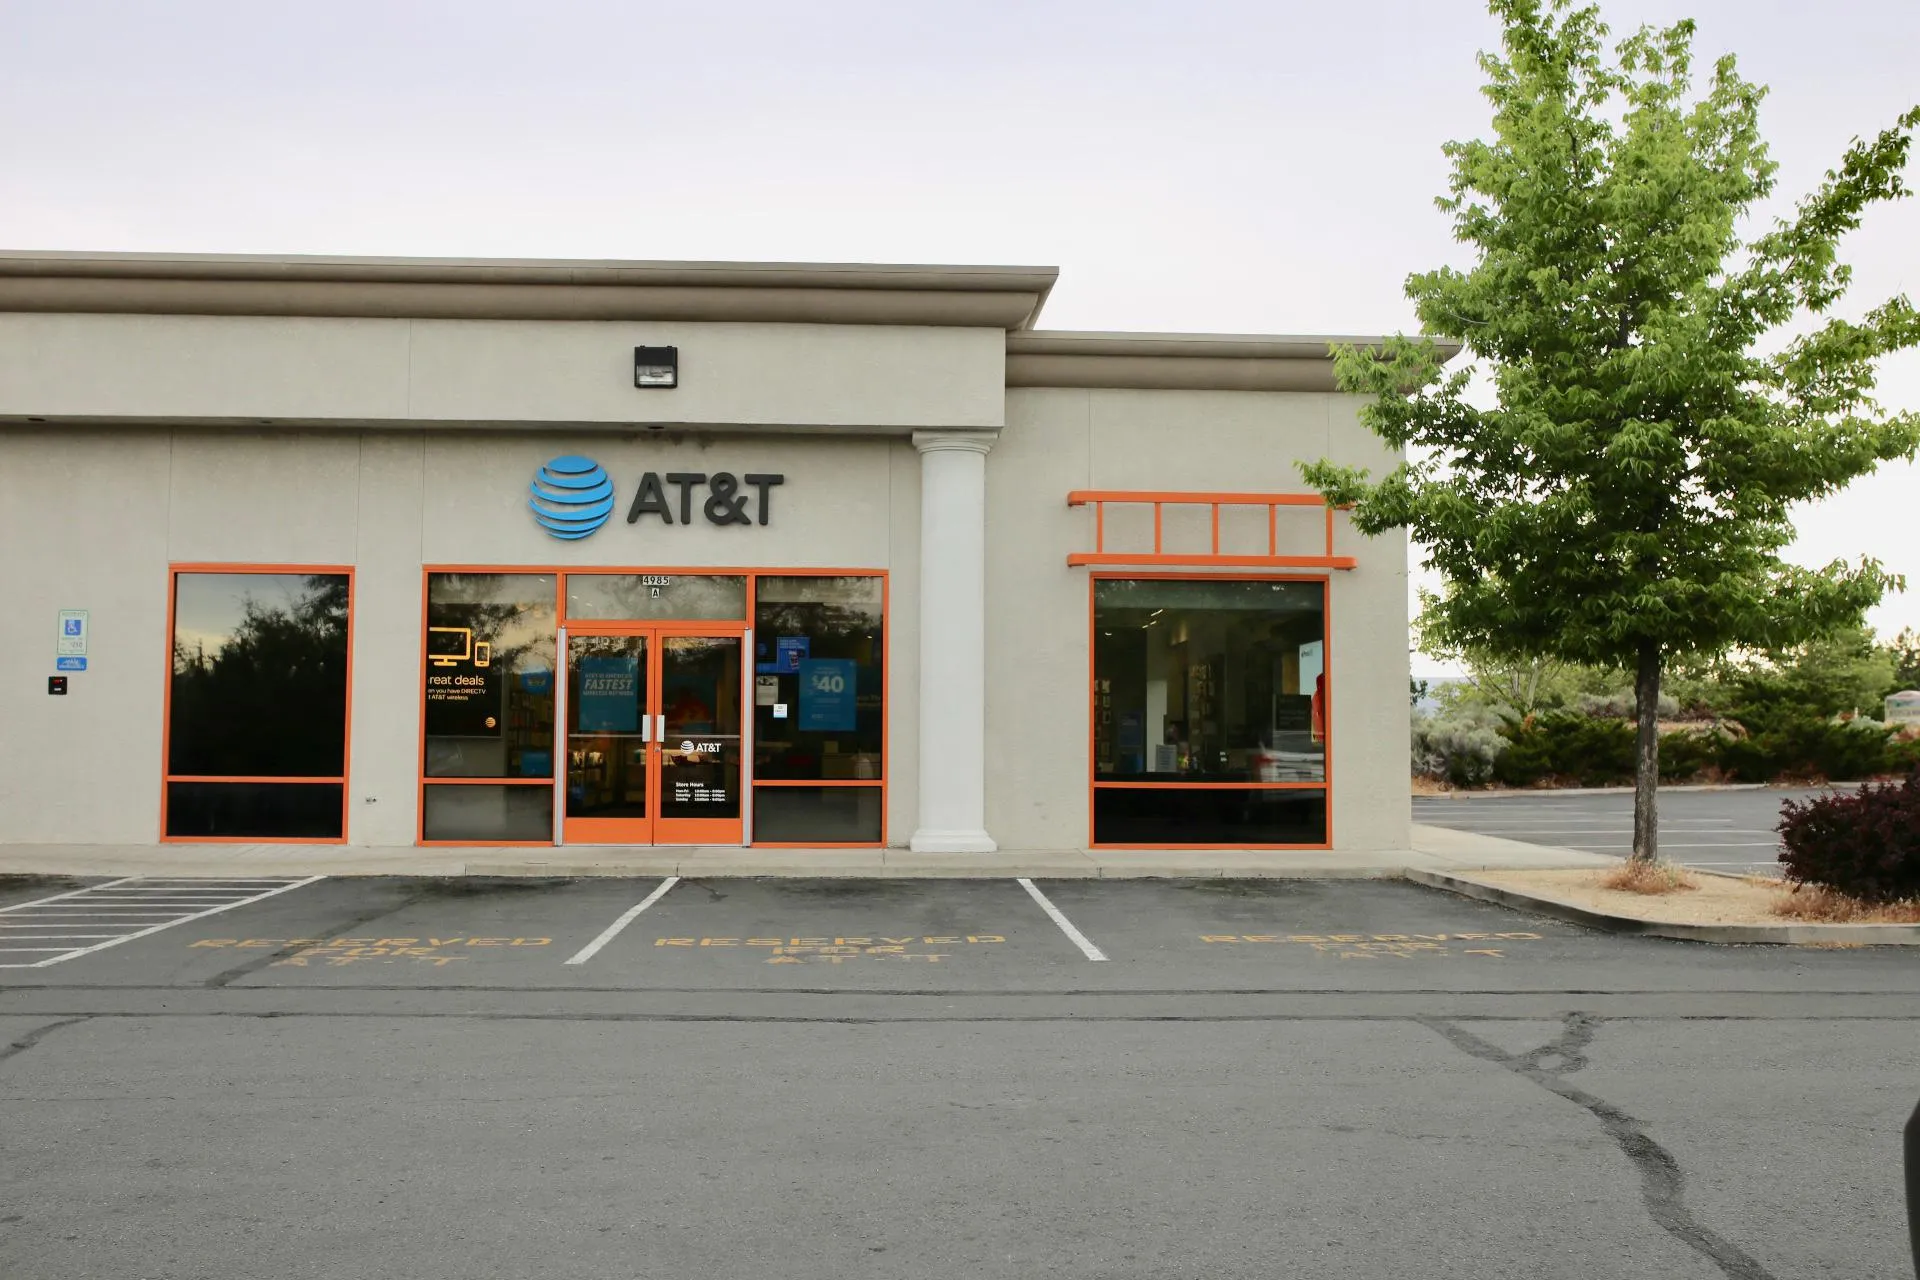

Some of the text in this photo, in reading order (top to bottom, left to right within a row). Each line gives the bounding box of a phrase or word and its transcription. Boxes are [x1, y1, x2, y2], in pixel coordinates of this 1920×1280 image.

[626, 472, 785, 525] AT&T
[643, 576, 669, 585] 4985
[652, 588, 659, 597] A
[428, 674, 485, 686] reat deals
[583, 678, 634, 690] FASTEST
[811, 675, 845, 693] $40
[695, 742, 722, 753] AT&T
[186, 938, 553, 948] RESERVED
[653, 935, 1007, 947] RESERVED
[300, 947, 446, 956] FOR
[773, 945, 905, 955] FOR
